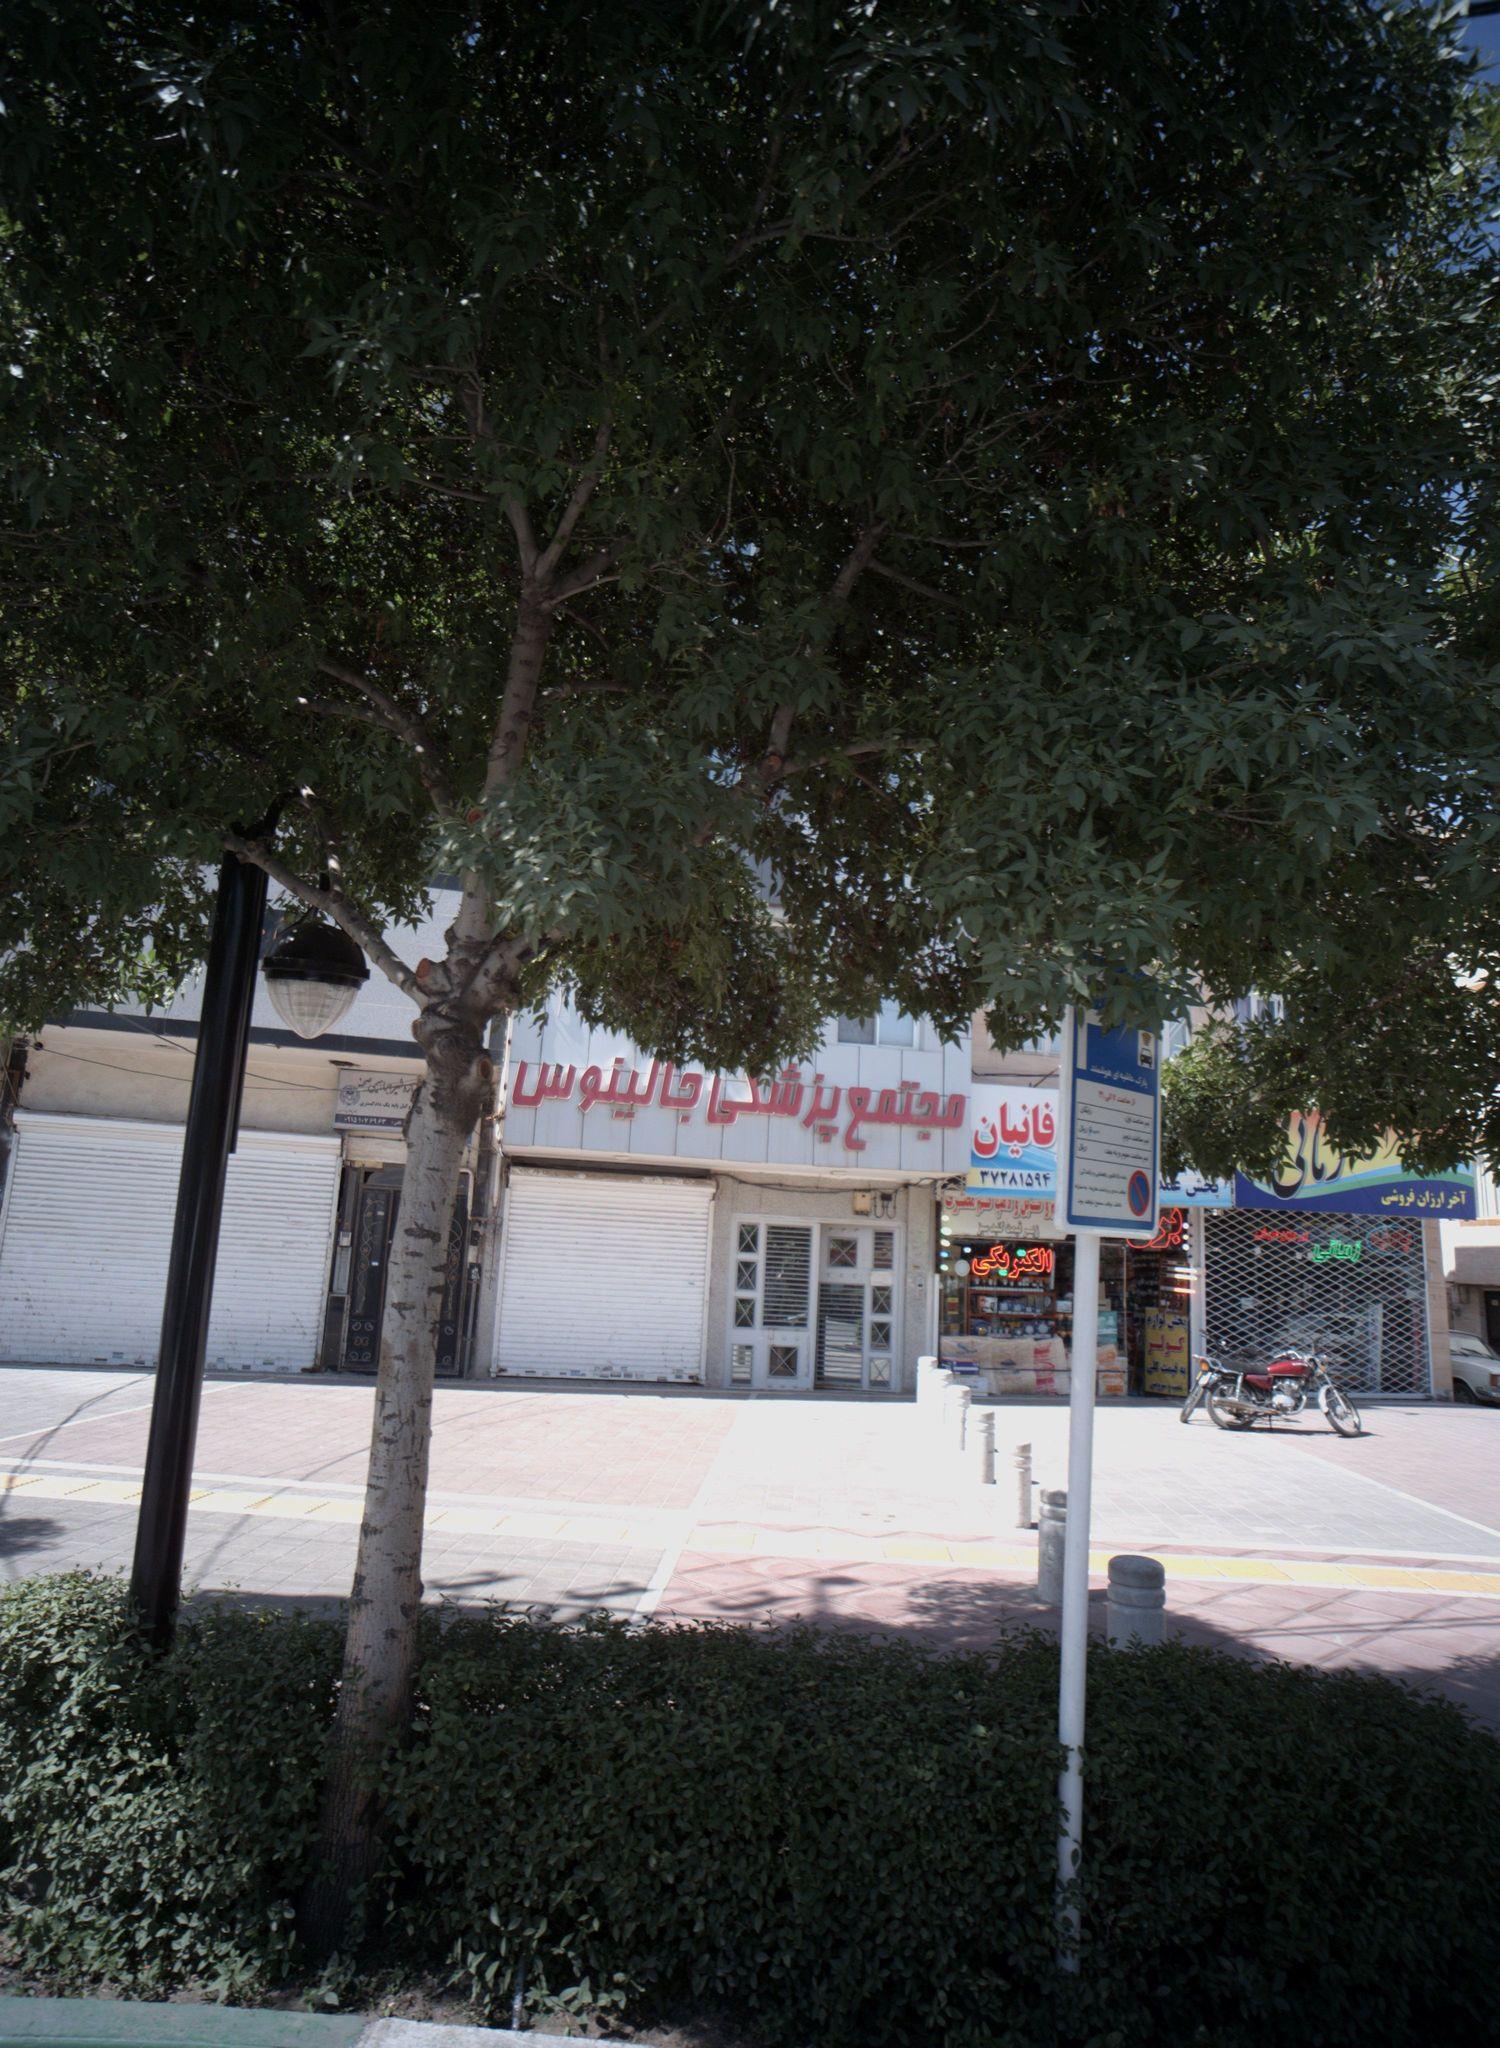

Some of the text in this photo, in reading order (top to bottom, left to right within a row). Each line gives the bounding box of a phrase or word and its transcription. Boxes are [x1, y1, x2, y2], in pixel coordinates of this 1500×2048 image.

[512, 1056, 966, 1151] مجتمع پزشکی جالینوس
[972, 1101, 1056, 1157] فانیان
[979, 1169, 1052, 1188] ۳۷۲۸۱۵۹۴
[1381, 1187, 1467, 1209] آخر ارزان فروشی
[972, 1244, 1053, 1279] الکتریکی
